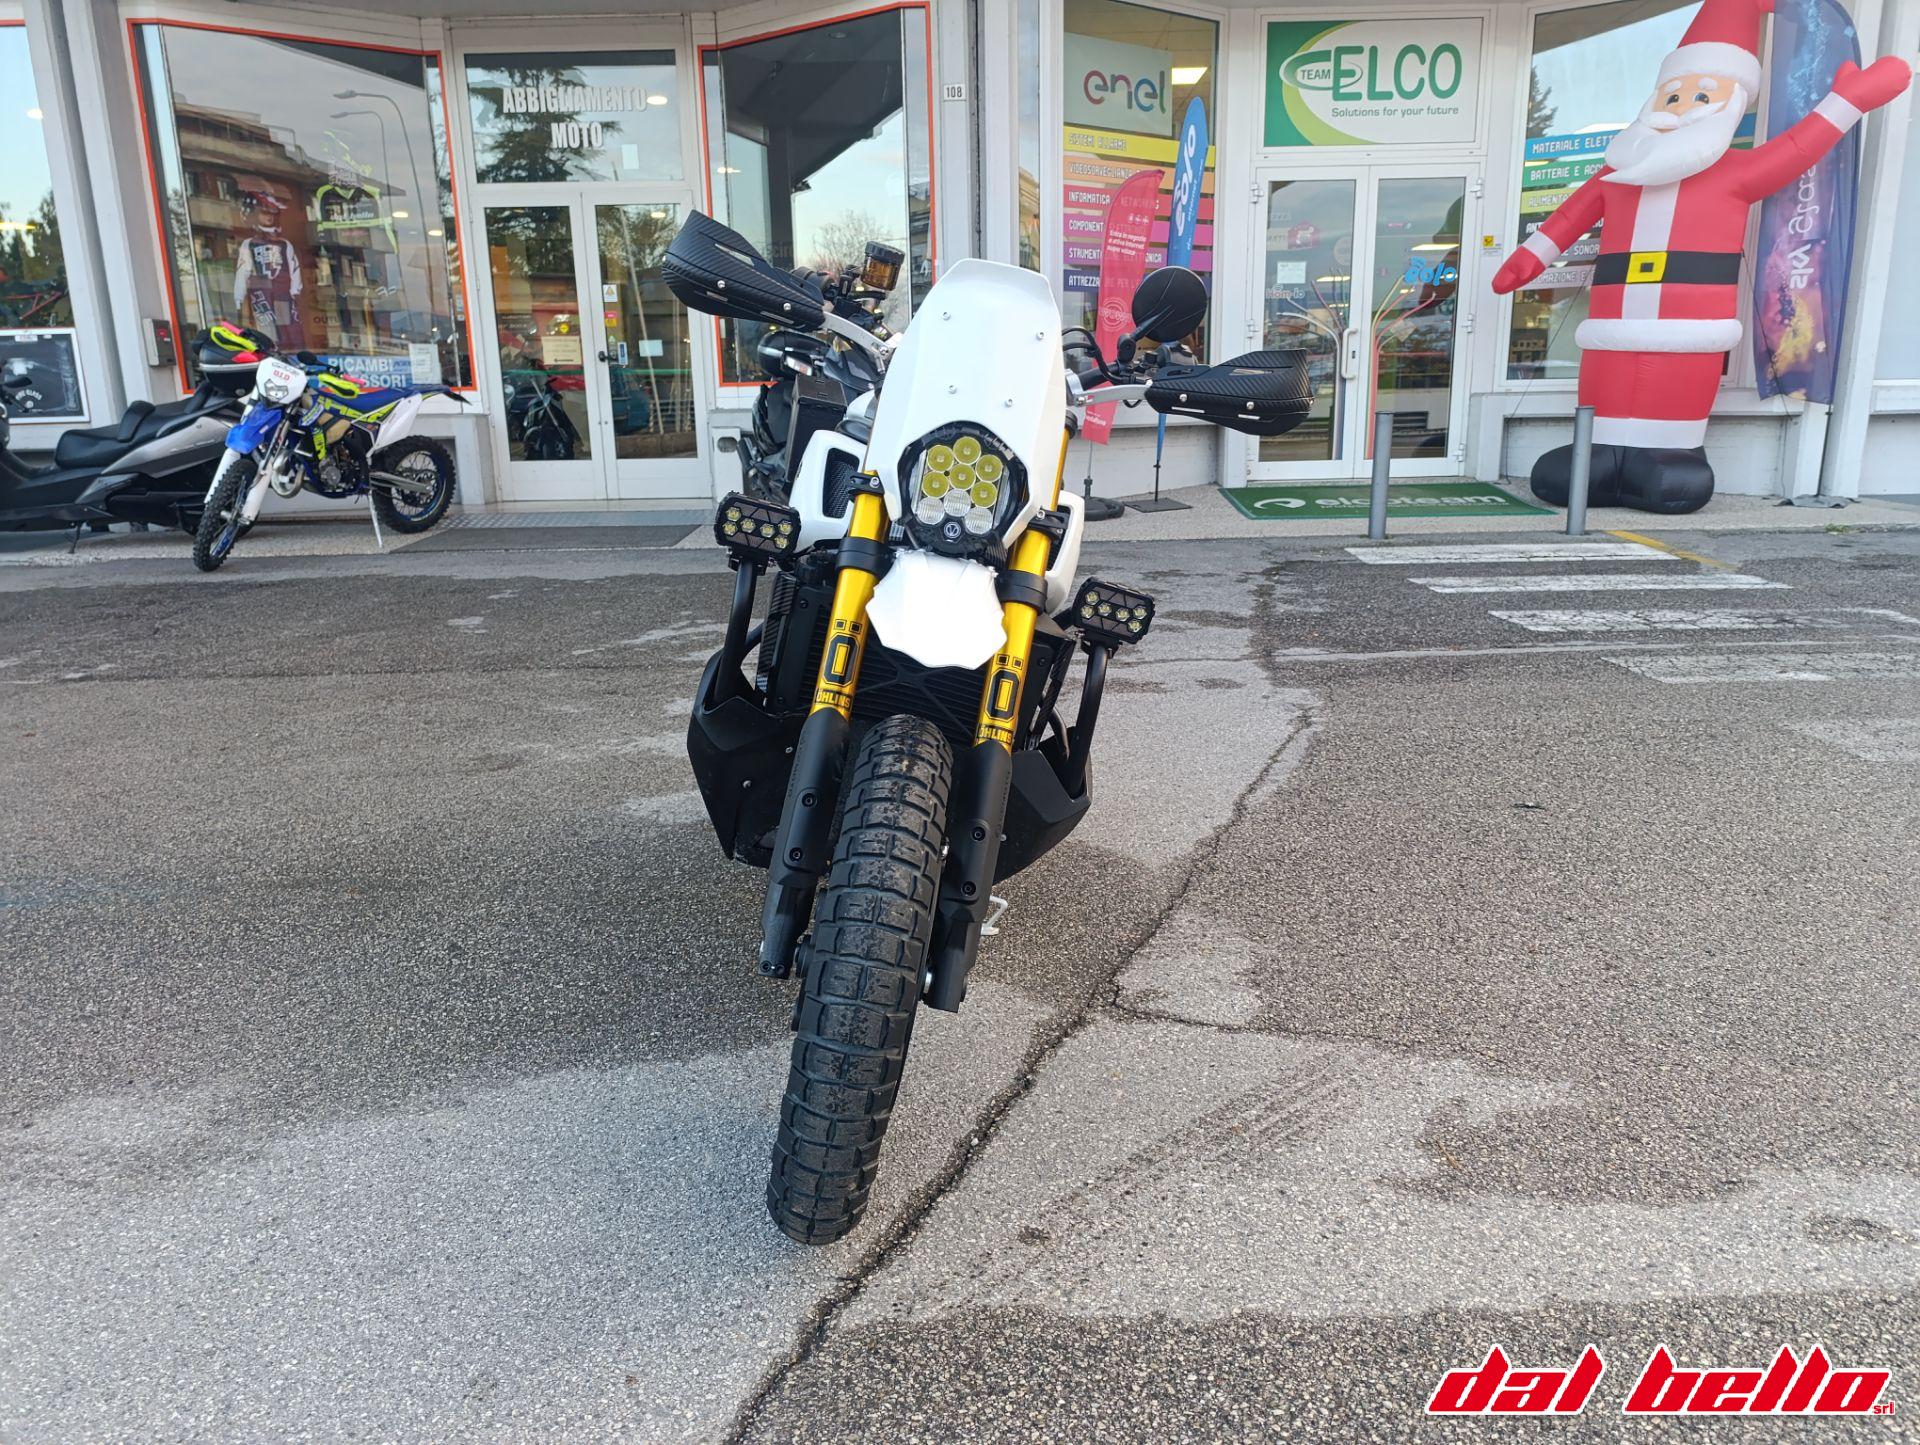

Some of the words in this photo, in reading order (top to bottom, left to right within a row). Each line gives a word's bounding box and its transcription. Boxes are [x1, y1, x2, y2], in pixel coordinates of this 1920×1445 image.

[1301, 69, 1331, 80] TEAM
[1332, 43, 1462, 101] ELCO
[503, 86, 647, 113] ABBIGLIAMENTO
[946, 86, 962, 98] 108
[1083, 70, 1166, 114] enel
[1331, 107, 1380, 118] Solutions
[1382, 106, 1398, 117] for
[1401, 106, 1424, 118] your
[1426, 105, 1459, 115] future
[551, 121, 603, 149] MOTO
[1532, 139, 1580, 154] MATERIALE
[1530, 165, 1570, 181] BATTERIE
[1574, 166, 1580, 176] E
[1068, 191, 1111, 205] INFORMATICA
[816, 688, 851, 708] ÖHLINS
